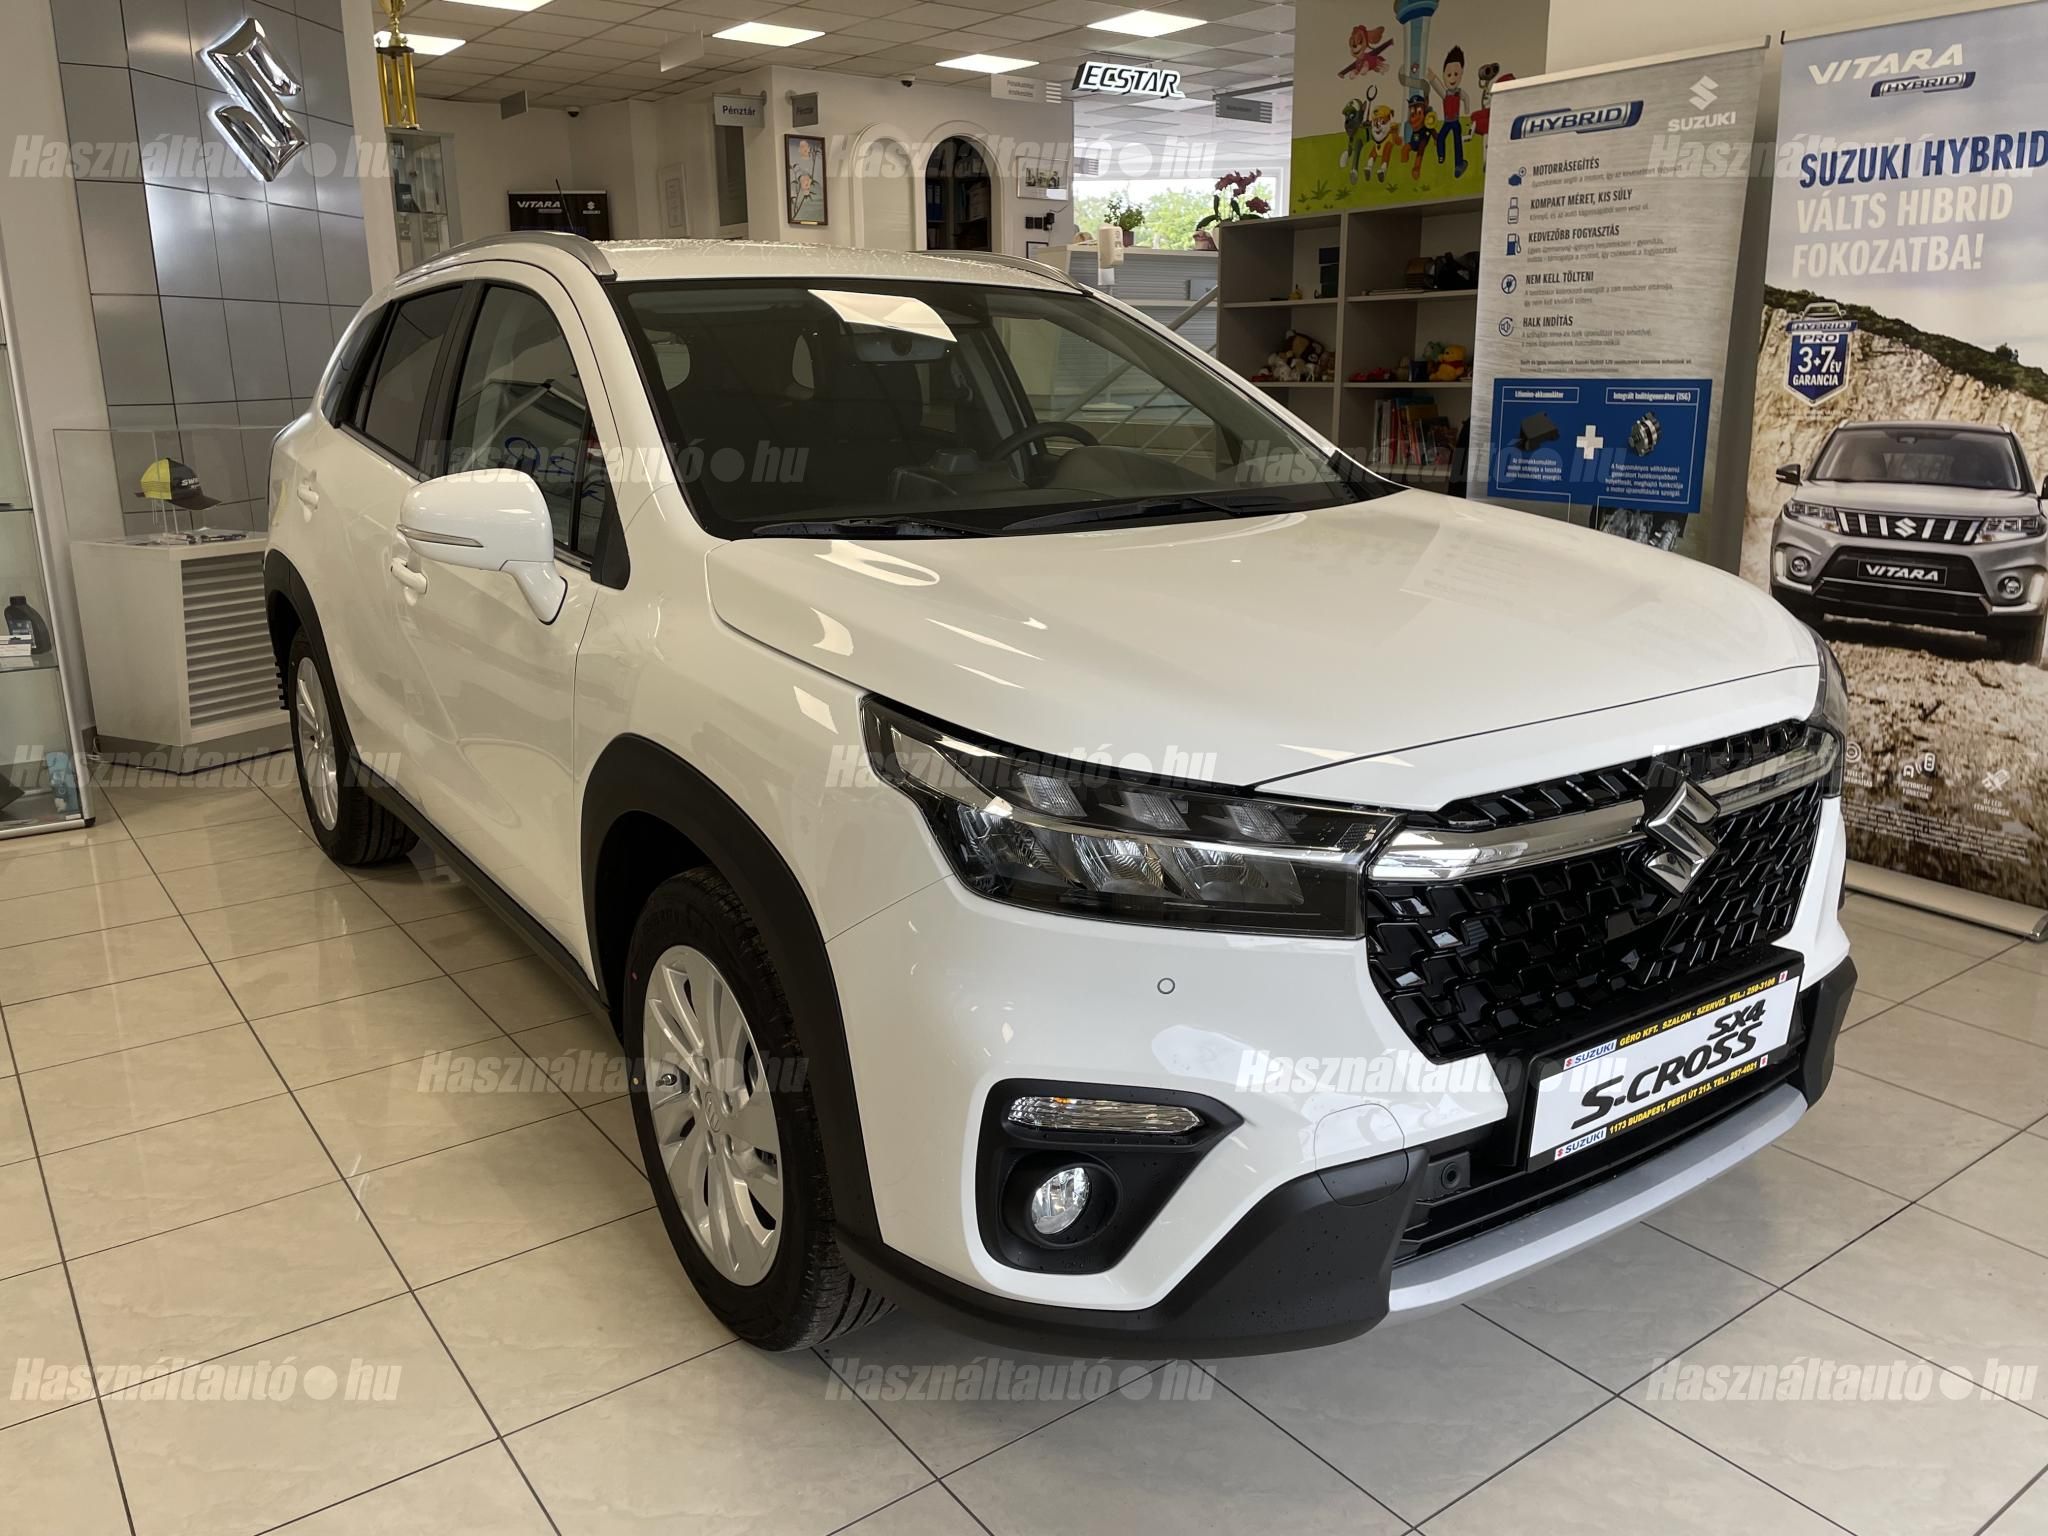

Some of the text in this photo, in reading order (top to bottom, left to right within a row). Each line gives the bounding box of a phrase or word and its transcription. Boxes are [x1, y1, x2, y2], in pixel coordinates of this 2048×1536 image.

[1808, 43, 1963, 85] VITARA
[1083, 64, 1181, 96] ECSTAR
[1886, 75, 1961, 93] HYBRID
[722, 105, 756, 116] Pénztár
[1529, 107, 1623, 134] HYBRID
[1667, 111, 1736, 133] SUZUKI
[1532, 157, 1600, 176] MOTORRÁSEGÍTÉS
[1800, 130, 2048, 188] SUZUKI HYBRID
[517, 200, 561, 208] VITARA
[1530, 188, 1633, 210] KOMPAKT MÉRET, KIS SÚLY
[1796, 183, 2013, 234] VÁLTS HIBRID
[1572, 224, 1620, 239] FOGYASZTÁS
[1791, 232, 1985, 279] FOKOZATBA!
[1525, 270, 1594, 285] NEM KELL TÖLTENI
[1522, 314, 1574, 328] HALK INDÍTÁS
[1802, 334, 1838, 342] PRO
[1830, 360, 1842, 373] ÉV
[1792, 374, 1839, 386] GARANCIA
[1865, 563, 1939, 582] VITARA
[1707, 998, 1767, 1041] SX4
[1575, 1041, 1616, 1064] SUZUKI
[1661, 1010, 1692, 1030] SZALON
[1696, 997, 1727, 1016] SZERVIZ
[1565, 1130, 1604, 1154] SUZUKI
[1609, 1120, 1627, 1134] 1173
[1627, 1103, 1666, 1126] BUDAPEST,
[1666, 1094, 1687, 1110] PESTI
[1688, 1087, 1698, 1099] ÚT
